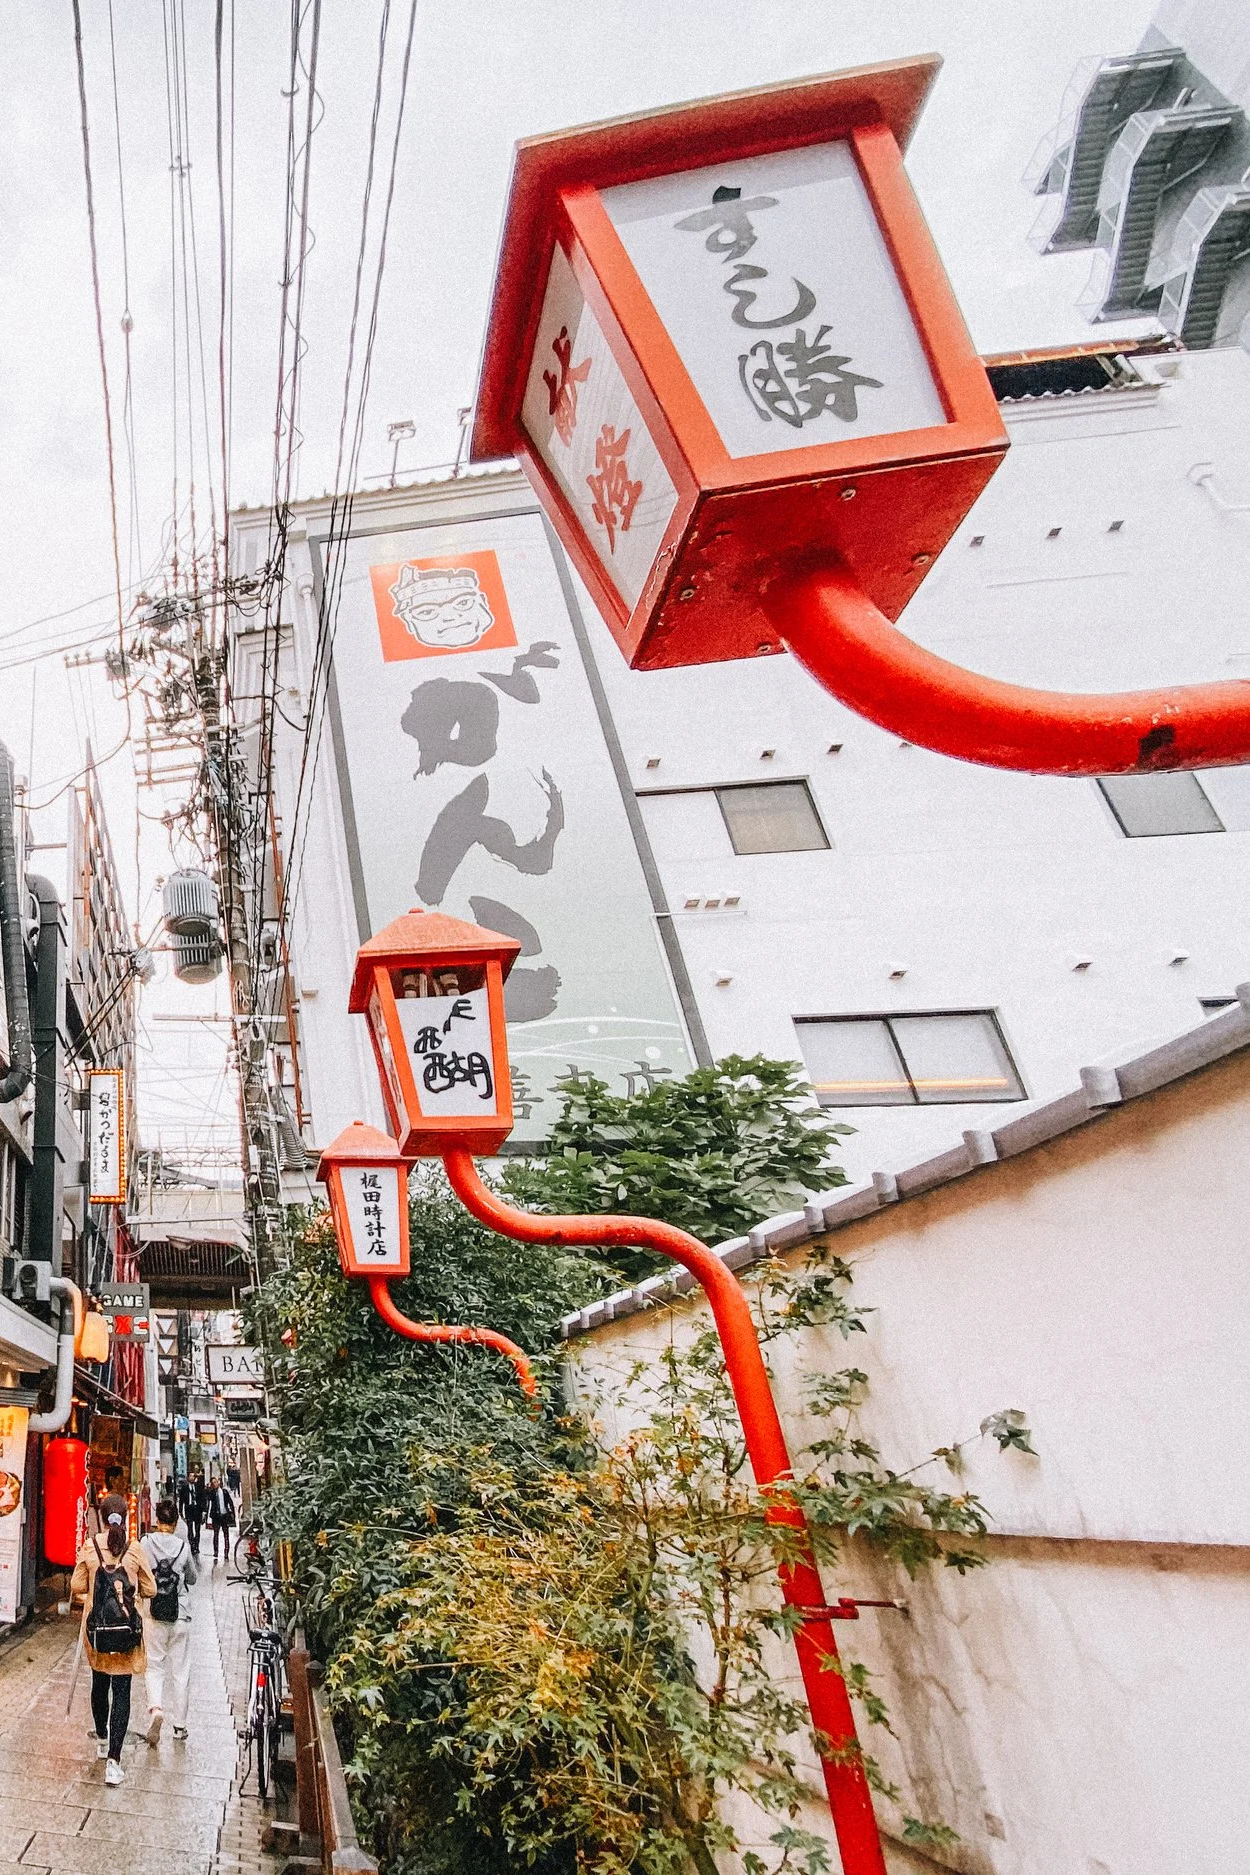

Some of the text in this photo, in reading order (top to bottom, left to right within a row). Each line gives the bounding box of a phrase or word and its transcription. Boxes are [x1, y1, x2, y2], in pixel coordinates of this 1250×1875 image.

[360, 1172, 387, 1257] 梶田時計店
[103, 1294, 144, 1307] GAME
